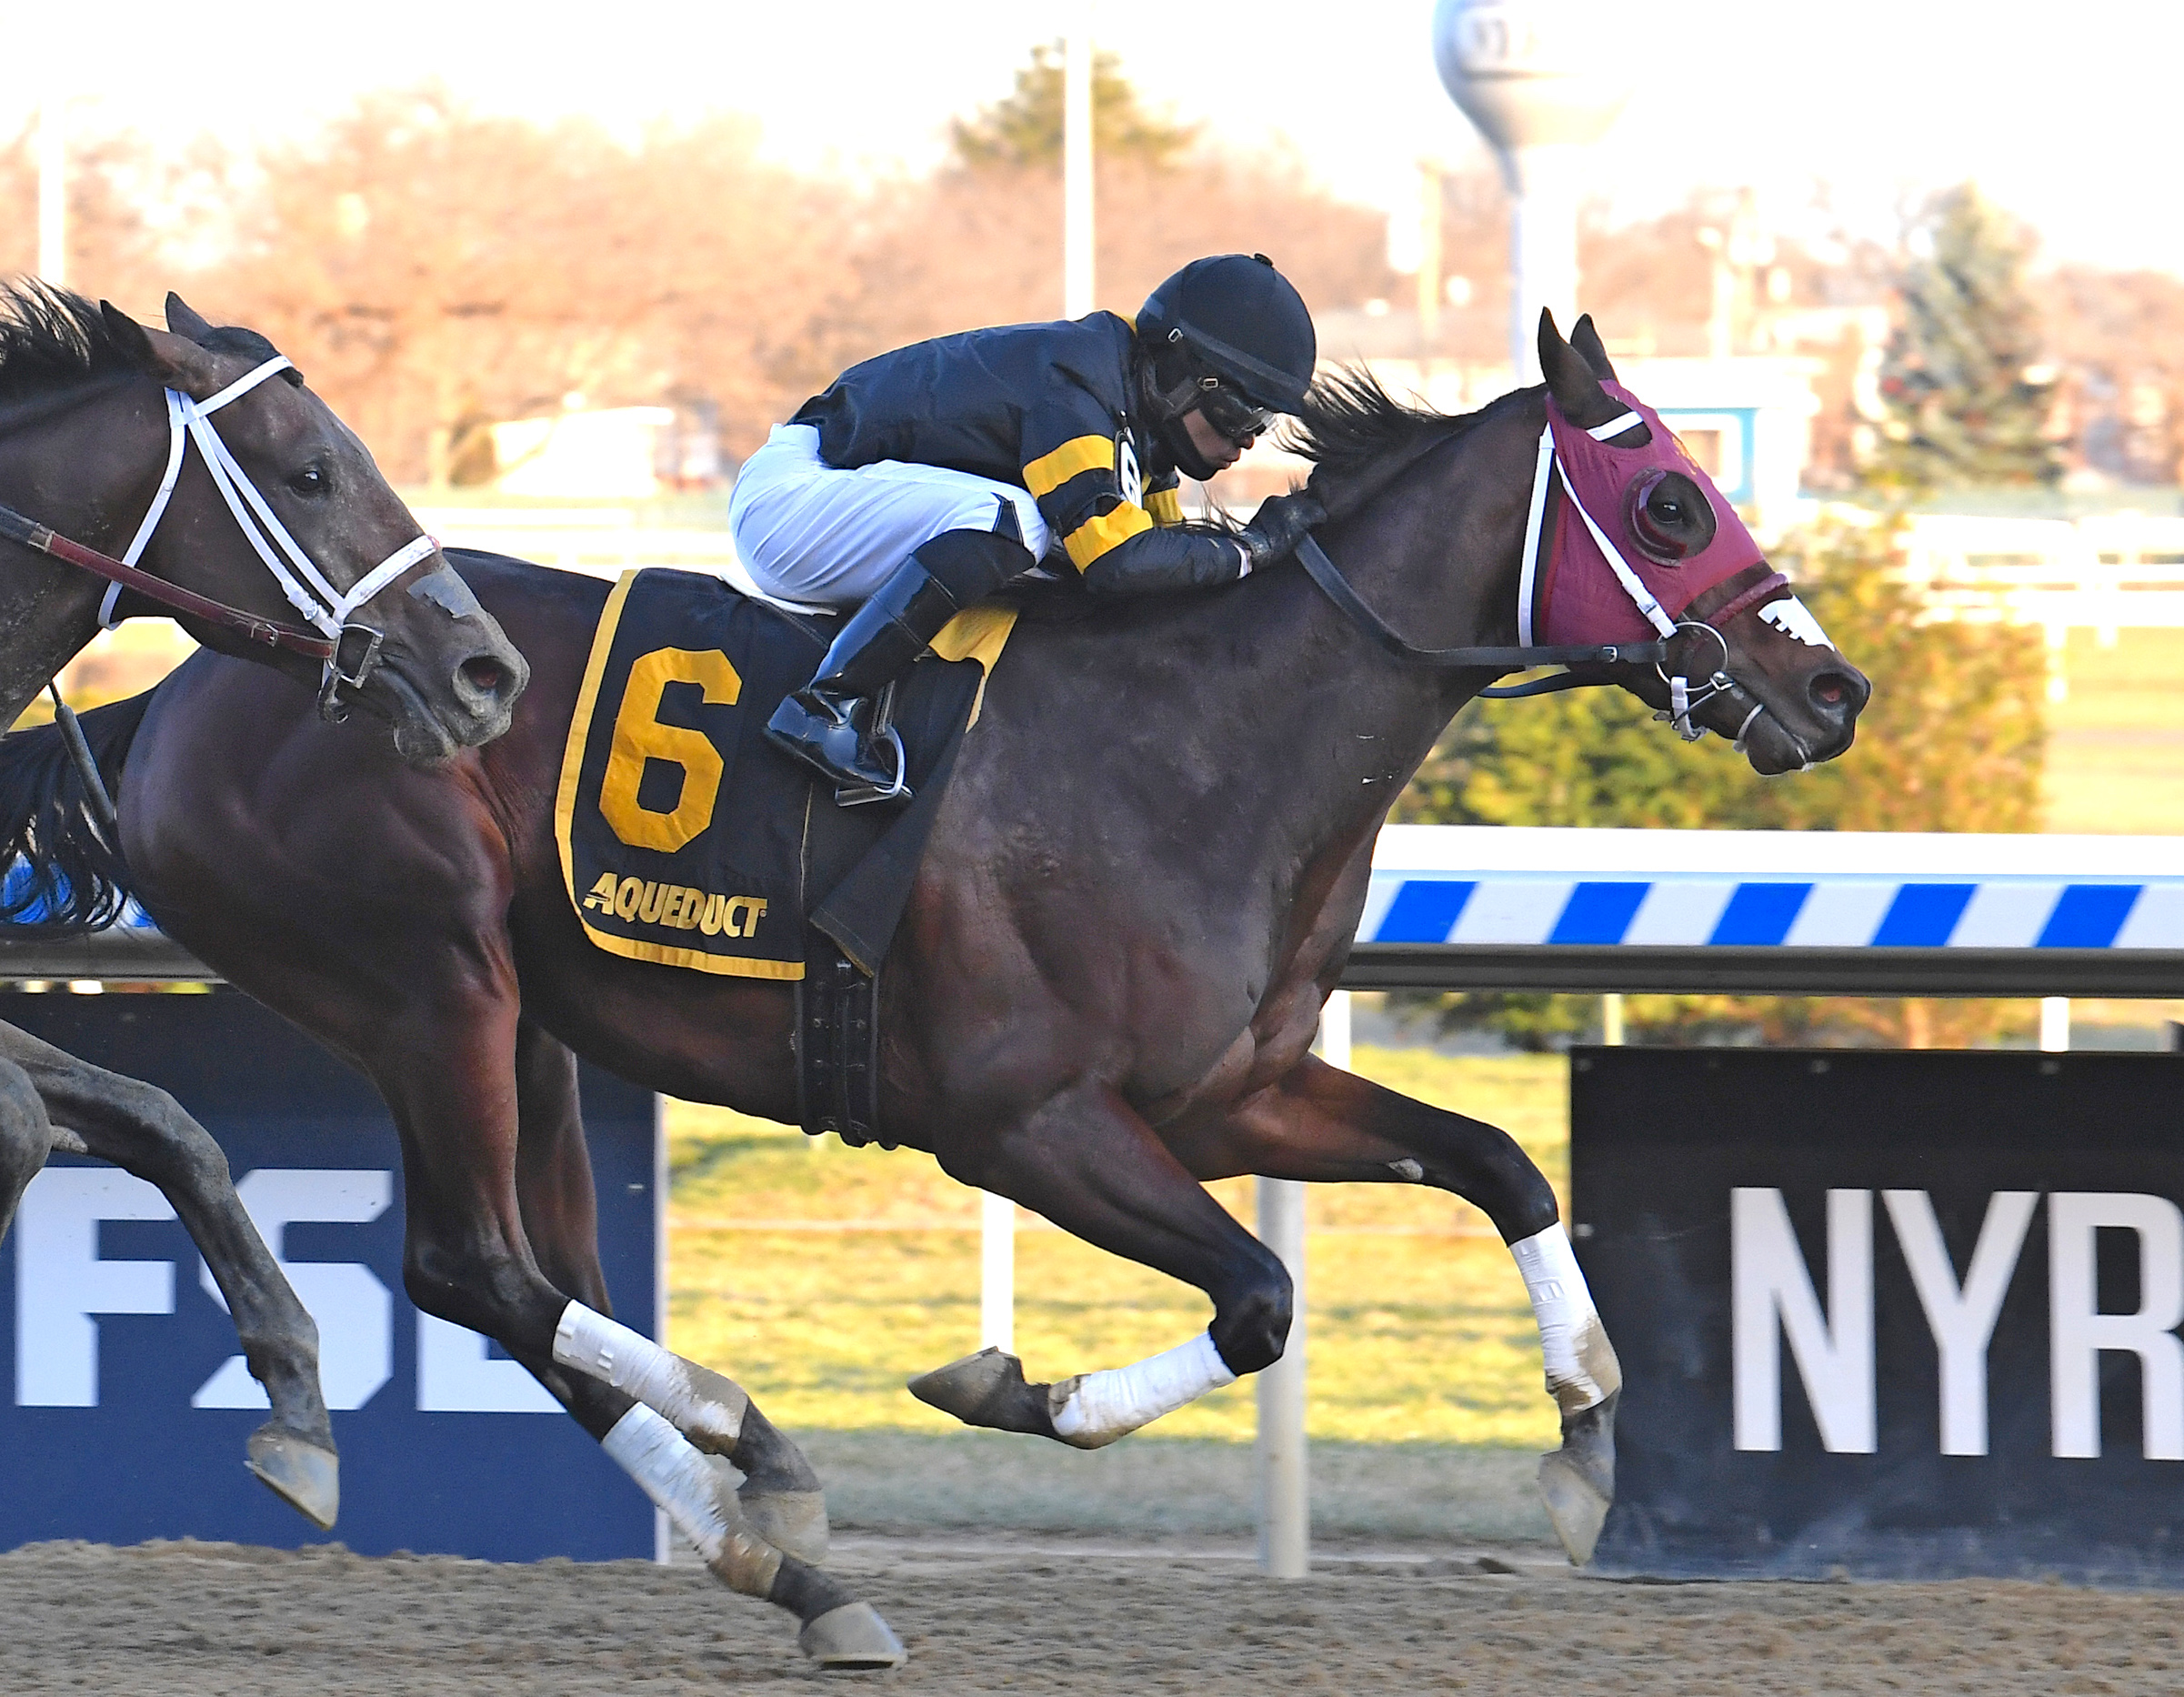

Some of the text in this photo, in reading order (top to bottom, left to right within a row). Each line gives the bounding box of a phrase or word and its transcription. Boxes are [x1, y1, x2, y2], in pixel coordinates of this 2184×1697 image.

[599, 646, 743, 854] 6
[583, 871, 767, 939] AQUEDUCT
[1729, 1187, 2184, 1461] NYR
